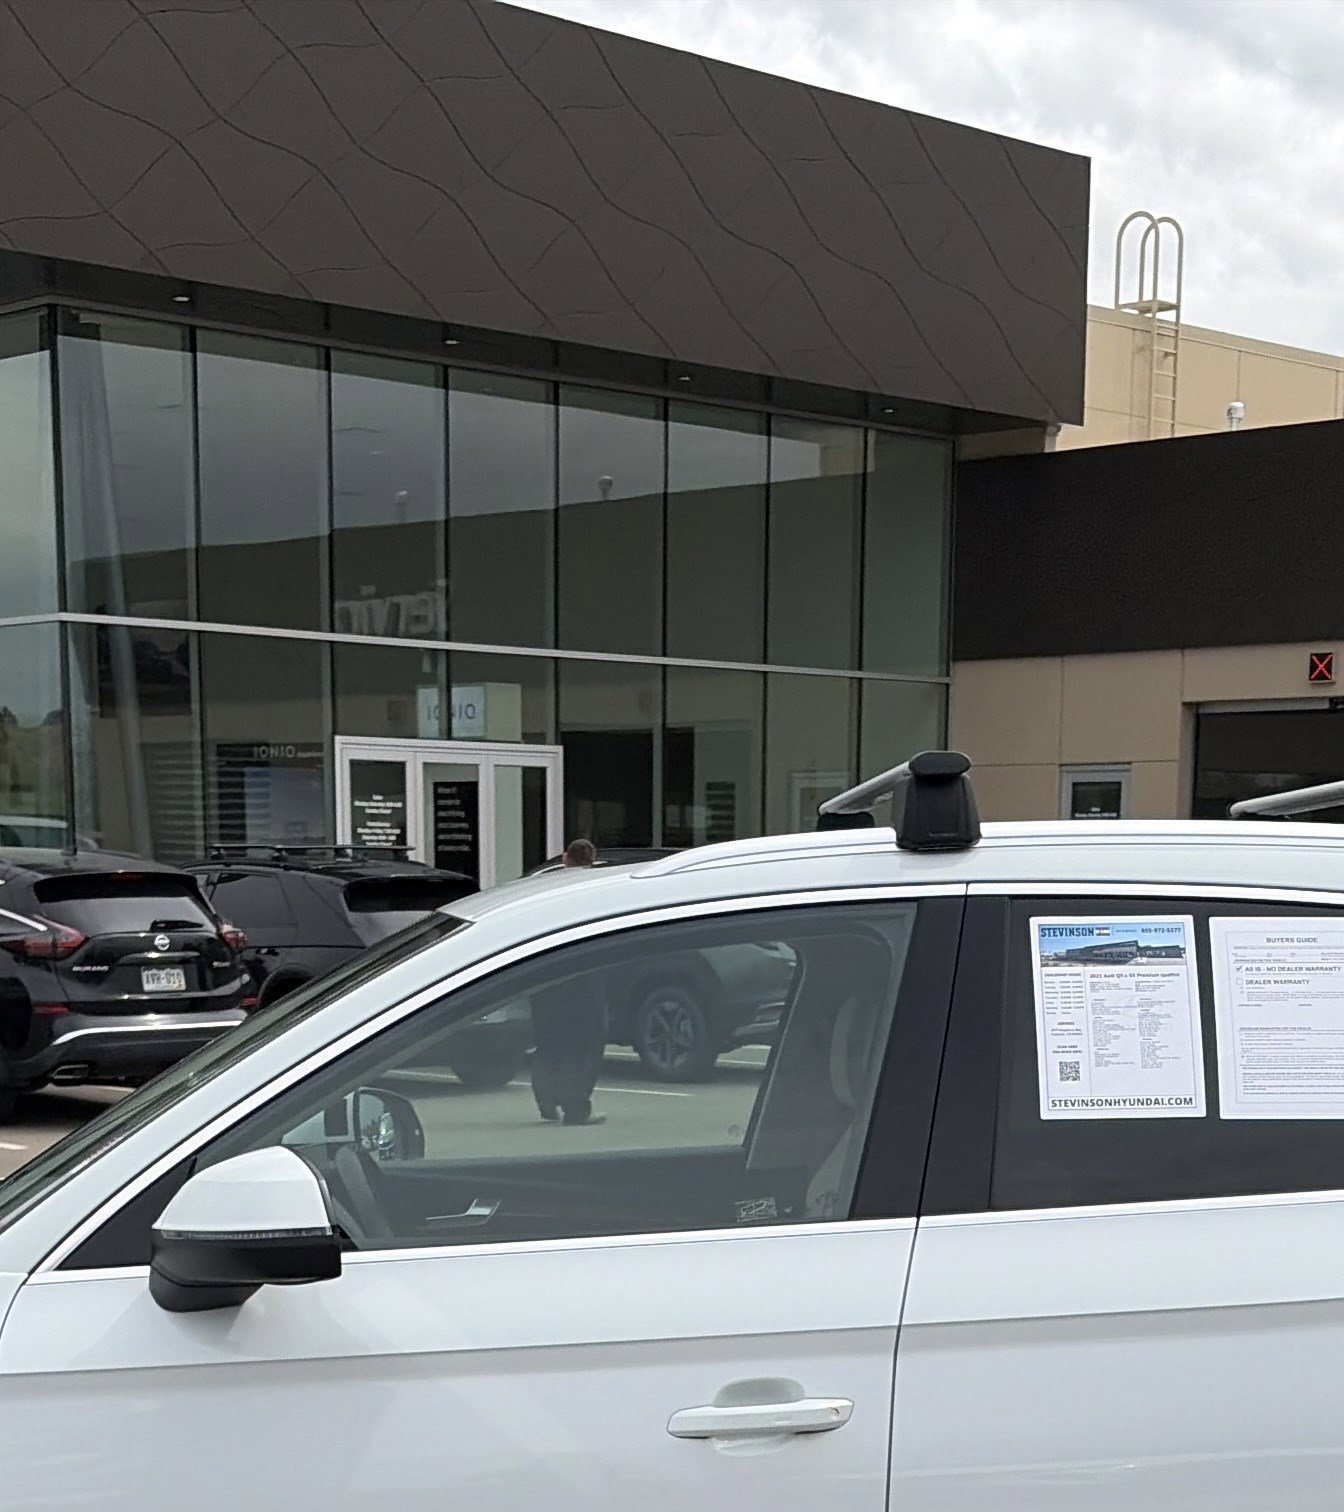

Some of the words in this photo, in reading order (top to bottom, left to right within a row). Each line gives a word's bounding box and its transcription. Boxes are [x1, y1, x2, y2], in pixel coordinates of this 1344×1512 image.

[426, 703, 477, 721] IOIQ
[1040, 927, 1094, 938] STEVINSON
[1051, 1097, 1194, 1108] STEVINSONHYUNDAI.COM
